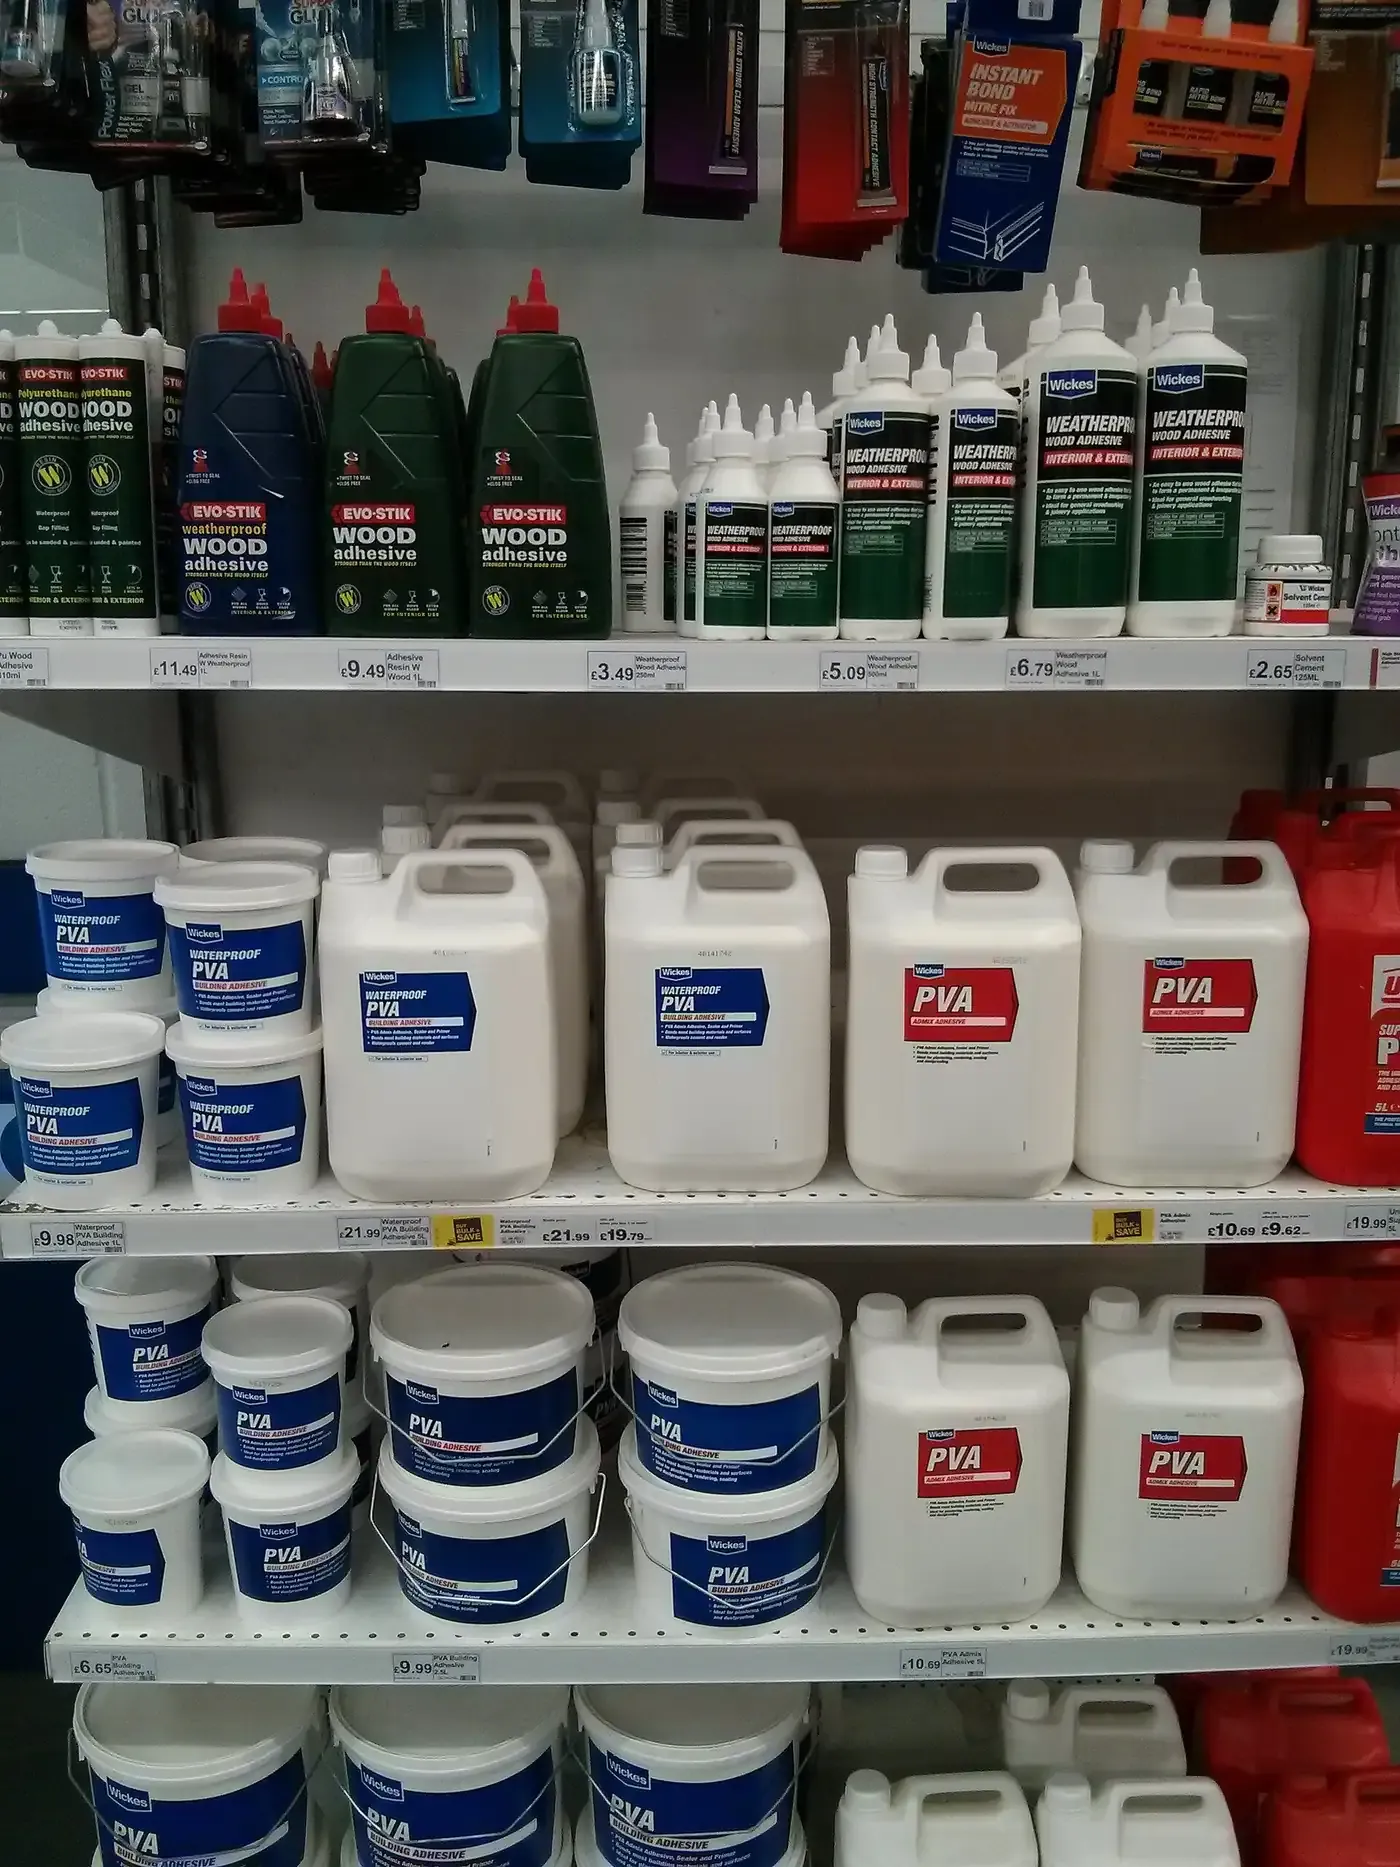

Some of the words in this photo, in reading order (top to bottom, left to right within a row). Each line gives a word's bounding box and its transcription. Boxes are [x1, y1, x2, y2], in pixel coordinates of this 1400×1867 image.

[969, 63, 1043, 85] INSTANT
[966, 81, 1015, 100] BOND
[1050, 379, 1094, 391] Wickes
[1157, 374, 1200, 386] Wickes
[850, 418, 881, 428] Wickes
[958, 414, 994, 424] Wickes
[1045, 436, 1074, 446] WOOD
[1076, 435, 1123, 446] ADHESIVE
[1152, 431, 1181, 441] WOOD
[1183, 430, 1231, 440] ADHESIVE
[1046, 454, 1092, 465] INTERIOR
[1153, 447, 1199, 459] INTERIOR
[846, 465, 865, 474] WOOD
[867, 465, 908, 473] ADHESIVE
[980, 462, 1012, 471] ADHESIVE
[333, 527, 417, 544] WOOD
[482, 528, 568, 545] WOOD
[772, 525, 832, 536] WEATHERPROOF
[183, 538, 268, 555] WOOD
[334, 546, 417, 560] adhesive
[482, 547, 568, 561] adhesive
[185, 557, 268, 571] adhesive
[387, 653, 424, 661] Adhesive
[341, 660, 385, 679] £9.49
[591, 663, 634, 681] £3.49
[822, 662, 866, 680] £5.09
[1010, 658, 1053, 677] £6.79
[1249, 661, 1292, 679] £2.65
[388, 673, 411, 681] Wood
[54, 914, 121, 925] WATERPROOF
[56, 926, 90, 943] PVA
[190, 949, 262, 960] WATERPROOF
[192, 961, 229, 980] PVA
[195, 981, 227, 990] BUILDING
[661, 986, 721, 995] WATERPROOF
[1152, 978, 1212, 1003] PVA
[365, 990, 427, 999] WATERPROOF
[912, 986, 972, 1012] PVA
[366, 1001, 400, 1016] PVA
[661, 996, 694, 1011] PVA
[24, 1102, 90, 1116] WATERPROOF
[190, 1100, 254, 1114] WATERPROOF
[26, 1114, 58, 1134] PVA
[192, 1112, 223, 1132] PVA
[340, 1226, 380, 1239] £21.99
[543, 1229, 590, 1241] £21.99
[600, 1229, 644, 1240] £19.79
[1115, 1228, 1140, 1236] SAVE
[1208, 1223, 1255, 1237] £10.69
[1261, 1222, 1300, 1235] £9.62
[34, 1230, 74, 1246] £9.98
[131, 1327, 163, 1335] Wickes
[133, 1344, 169, 1362] PVA
[237, 1411, 272, 1429] PVA
[409, 1413, 443, 1438] PVA
[651, 1414, 681, 1441] PVA
[442, 1443, 482, 1452] ADHESIVE
[682, 1447, 720, 1459] ADHESIVE
[927, 1445, 981, 1472] PVA
[1149, 1451, 1205, 1475] PVA
[264, 1546, 300, 1562] PVA
[402, 1540, 426, 1571] PVA
[708, 1566, 749, 1584] PVA
[711, 1585, 748, 1593] BUILDING
[750, 1577, 785, 1592] ADHESIVE
[74, 1660, 111, 1674] £6.65
[394, 1660, 432, 1674] £9.99
[608, 1757, 647, 1786] Wickes
[363, 1771, 400, 1797] Wickes
[109, 1784, 148, 1808] Wickes
[370, 1832, 410, 1856] BUILDING
[412, 1849, 466, 1860] ADHESIVE
[655, 1839, 709, 1850] ADHESIVE
